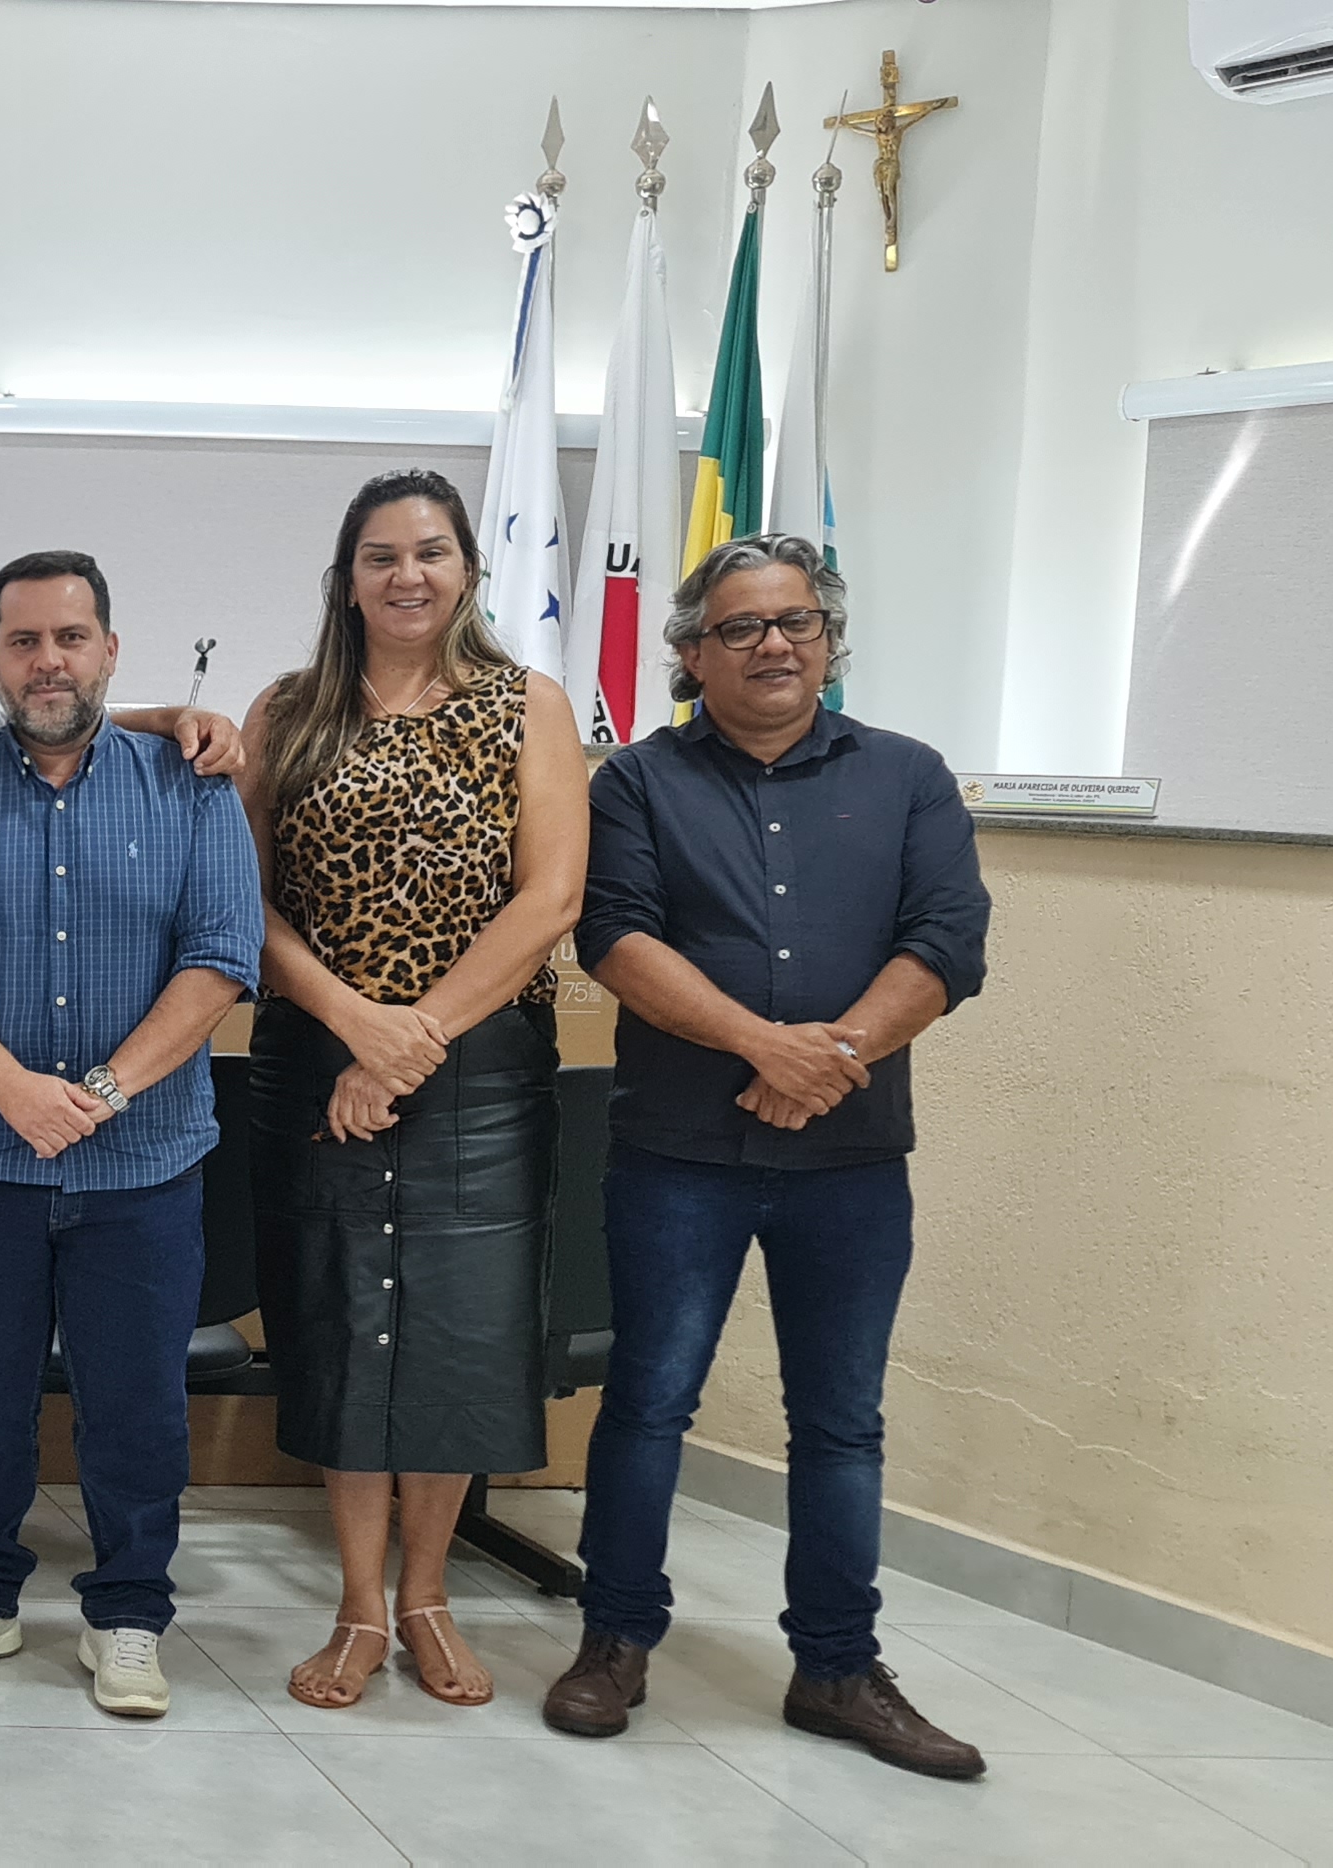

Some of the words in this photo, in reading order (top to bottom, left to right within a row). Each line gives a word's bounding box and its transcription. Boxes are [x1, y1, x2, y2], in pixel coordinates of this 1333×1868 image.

[993, 782, 1017, 790] MARIA
[1018, 782, 1058, 791] APARECIDA
[1059, 783, 1071, 792] DE
[1071, 783, 1105, 793] OLIVEIRA
